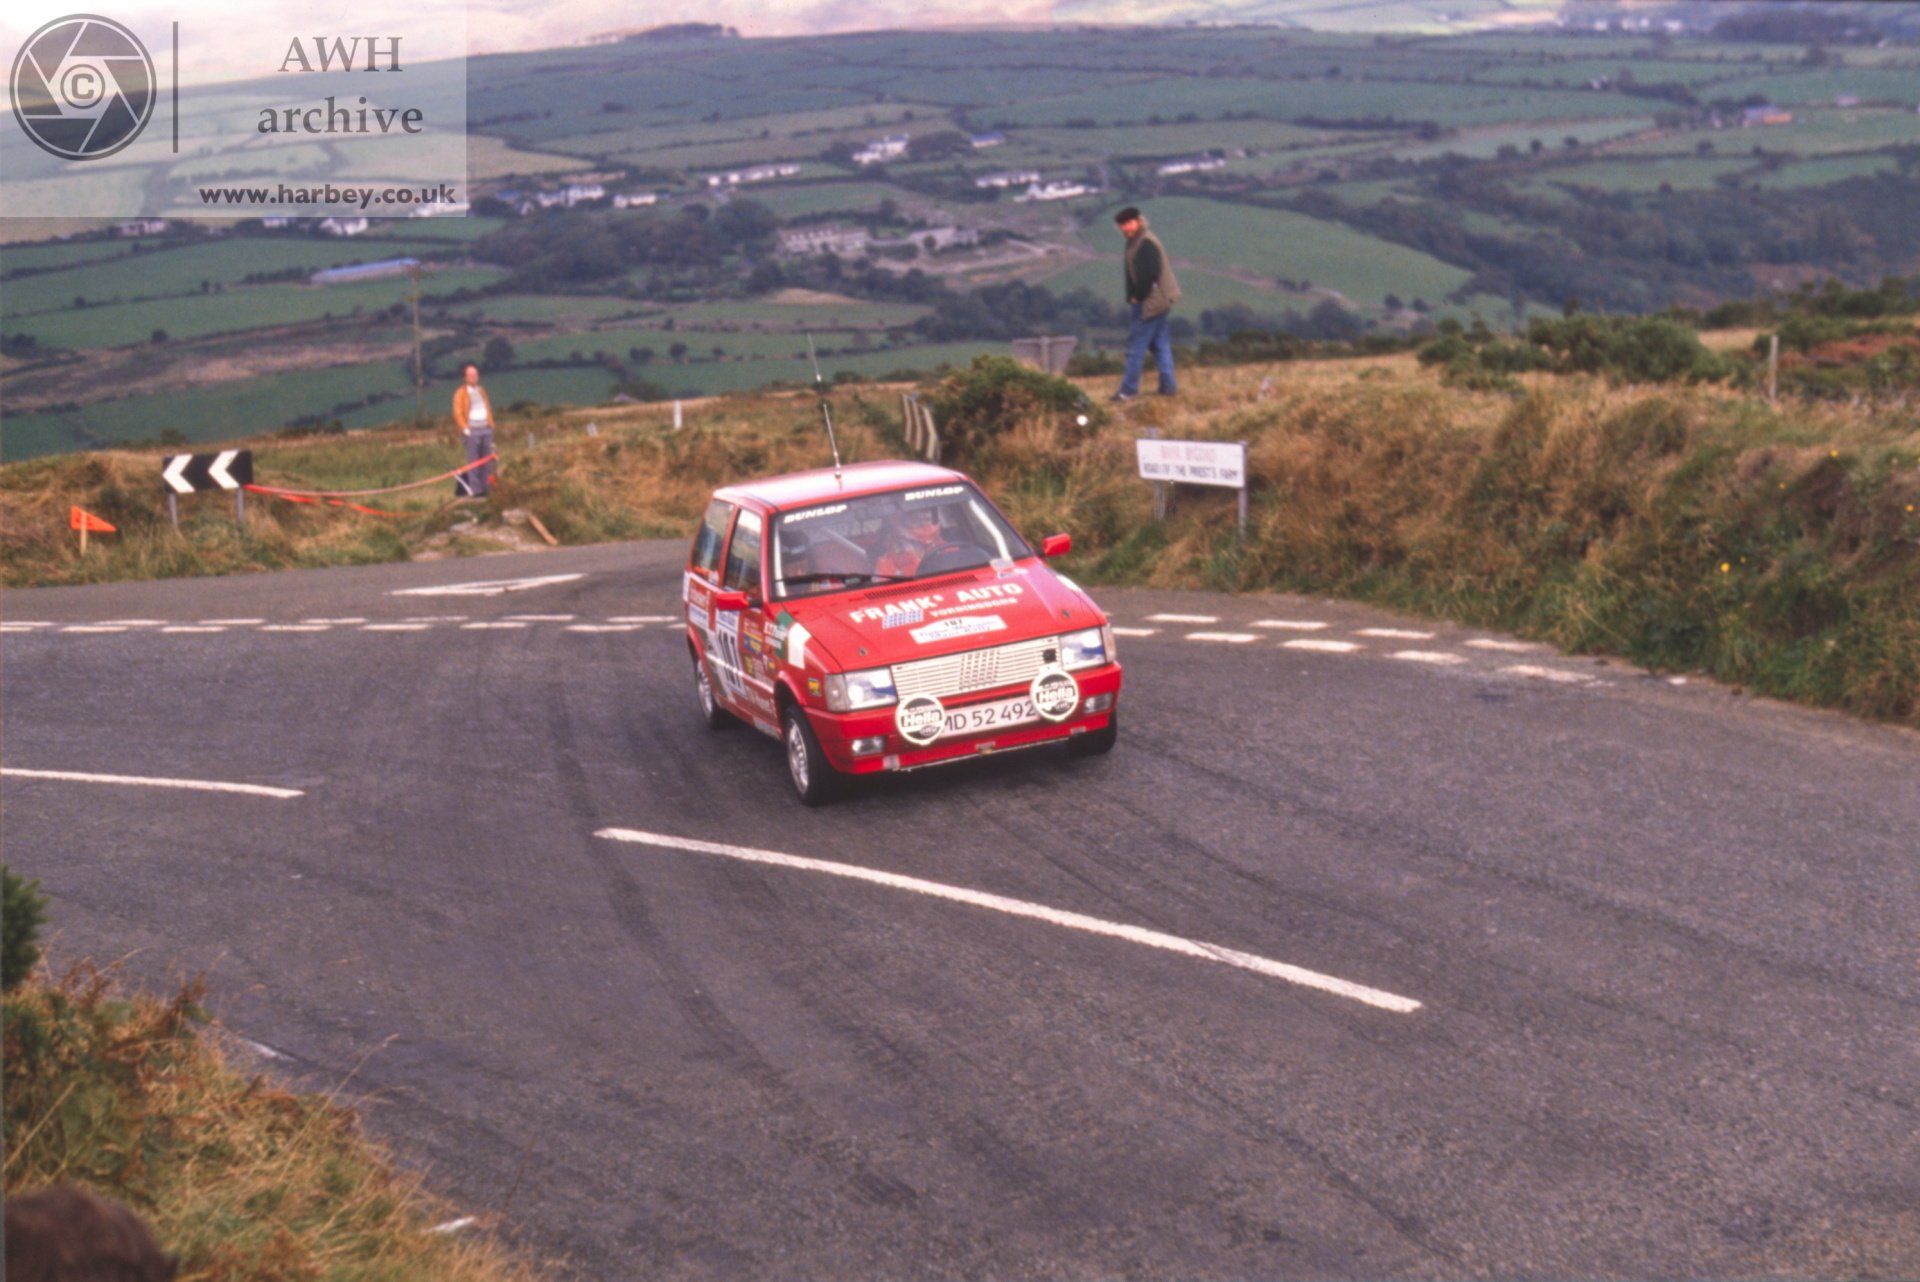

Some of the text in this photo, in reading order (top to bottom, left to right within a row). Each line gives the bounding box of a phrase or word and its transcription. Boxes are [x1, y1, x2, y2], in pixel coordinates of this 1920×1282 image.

[905, 486, 964, 501] DUNLOP
[784, 504, 848, 524] DUNLOP
[956, 582, 1023, 602] AUTO
[1038, 685, 1074, 703] Hella
[902, 710, 941, 728] Hella
[972, 708, 996, 727] 52
[1001, 701, 1036, 721] 492
